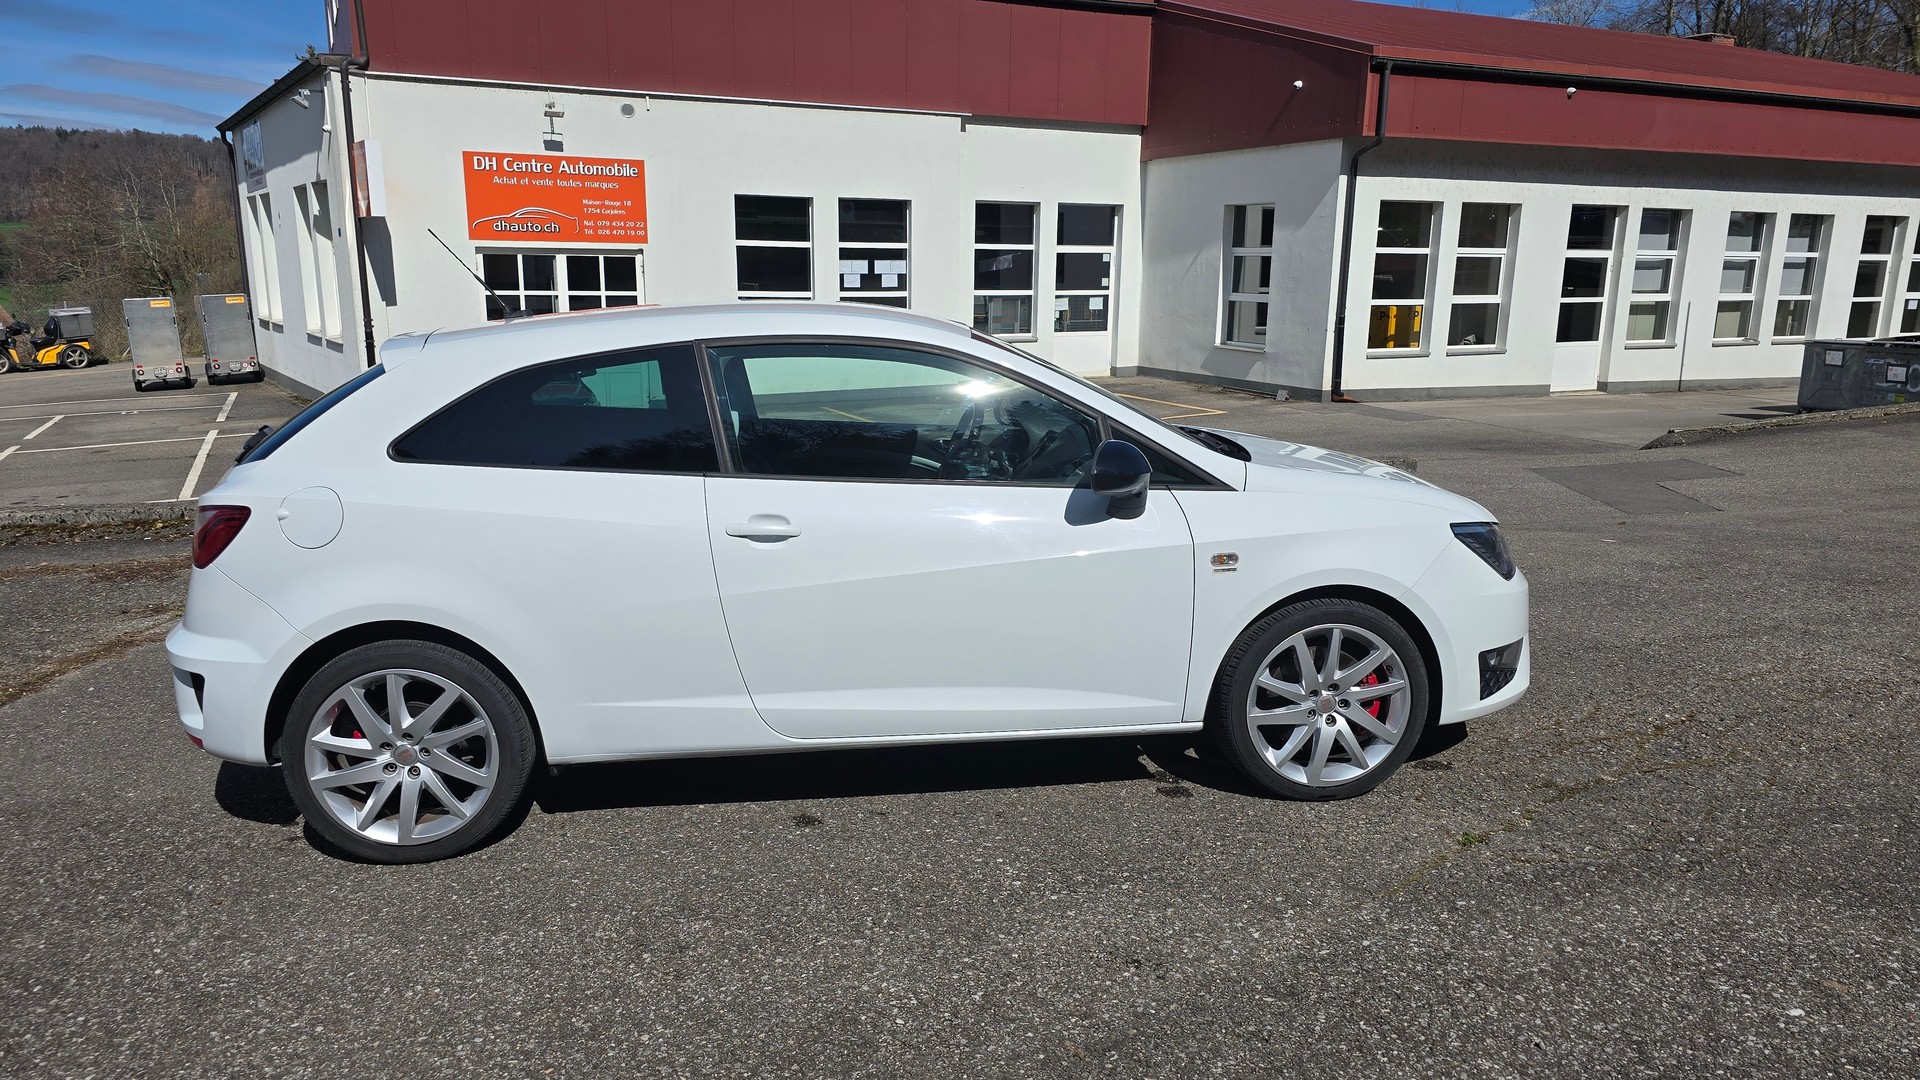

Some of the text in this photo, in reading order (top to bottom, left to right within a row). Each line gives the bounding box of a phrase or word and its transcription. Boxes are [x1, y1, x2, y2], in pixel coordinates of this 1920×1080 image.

[473, 155, 639, 178] DH Centre Automobile
[492, 175, 619, 190] Achat et vente toutes marques
[582, 199, 621, 207] Maison-Rouge
[492, 220, 560, 233] dhauto.ch
